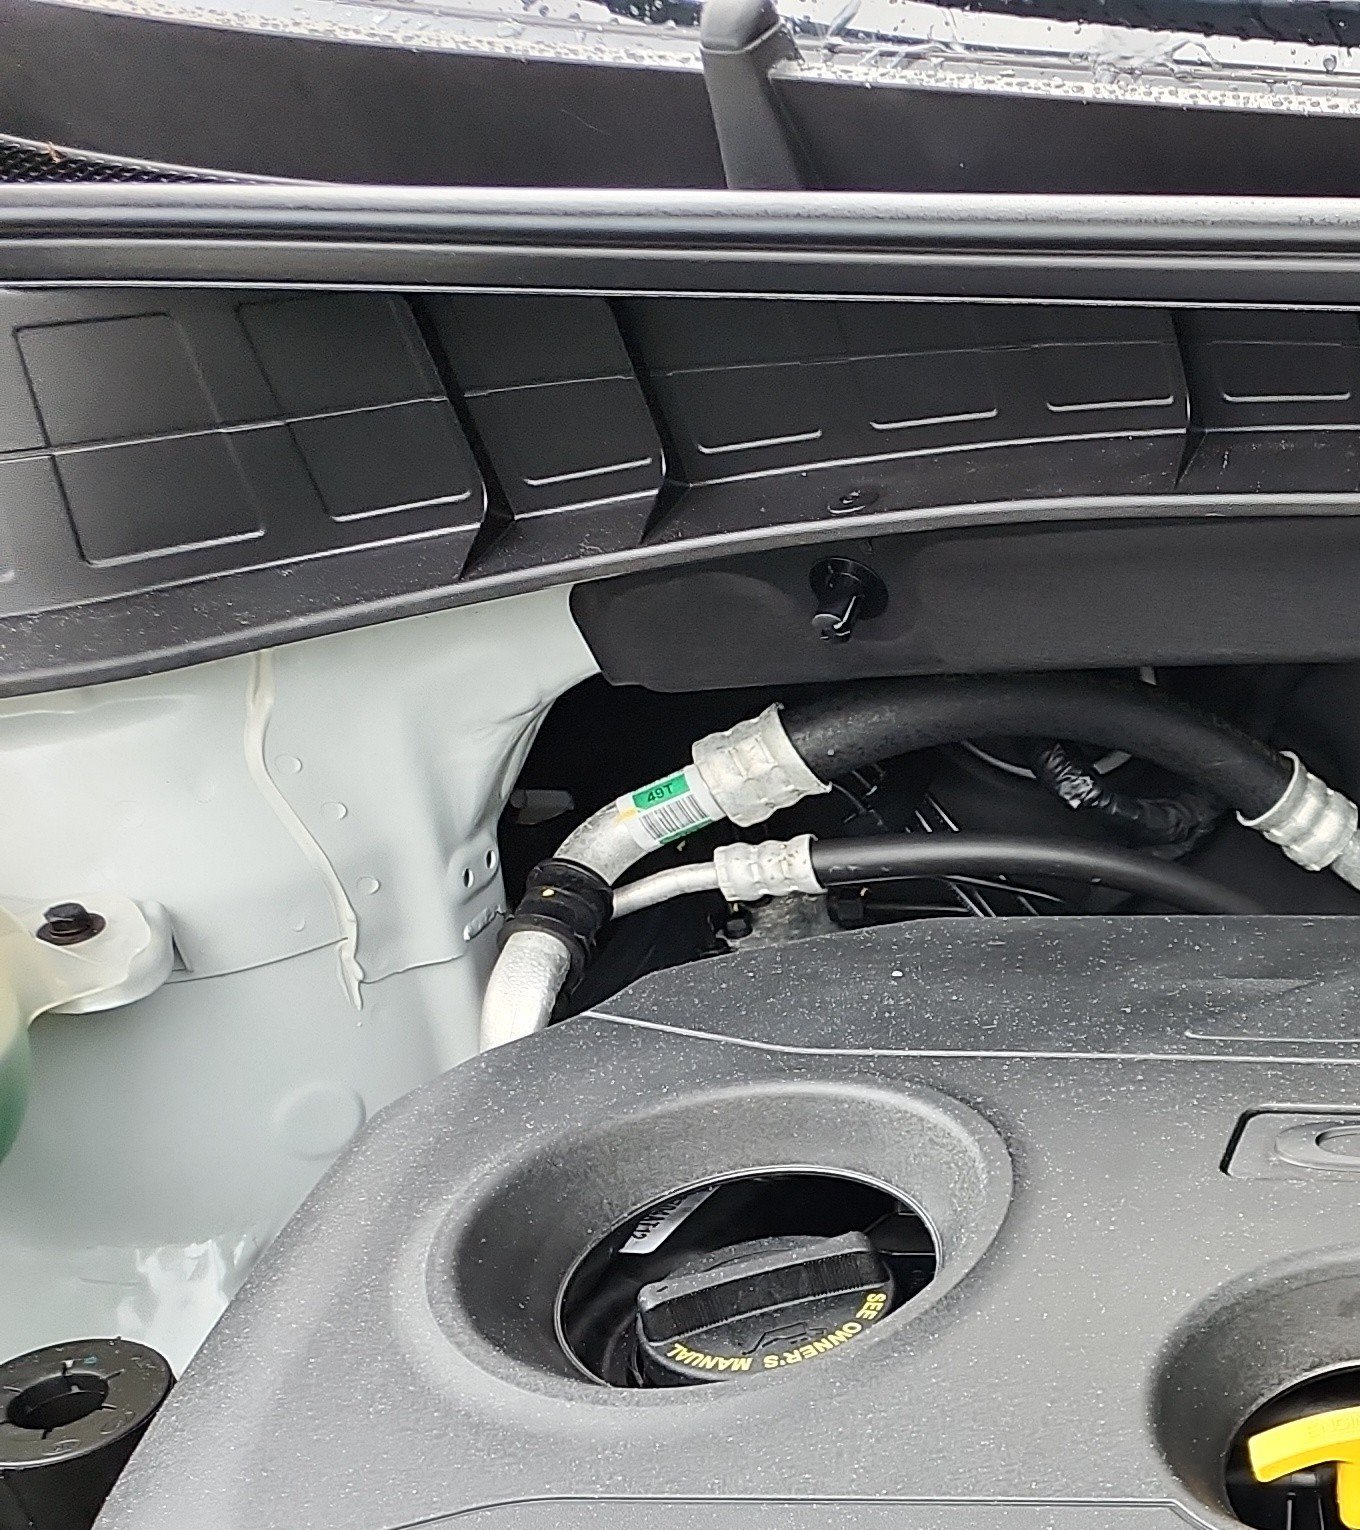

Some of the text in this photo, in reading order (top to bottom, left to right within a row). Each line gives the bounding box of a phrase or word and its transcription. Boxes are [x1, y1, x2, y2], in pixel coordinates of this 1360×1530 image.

[646, 783, 674, 804] 49T
[665, 1292, 887, 1373] SEE OWNER'S MANUAL
